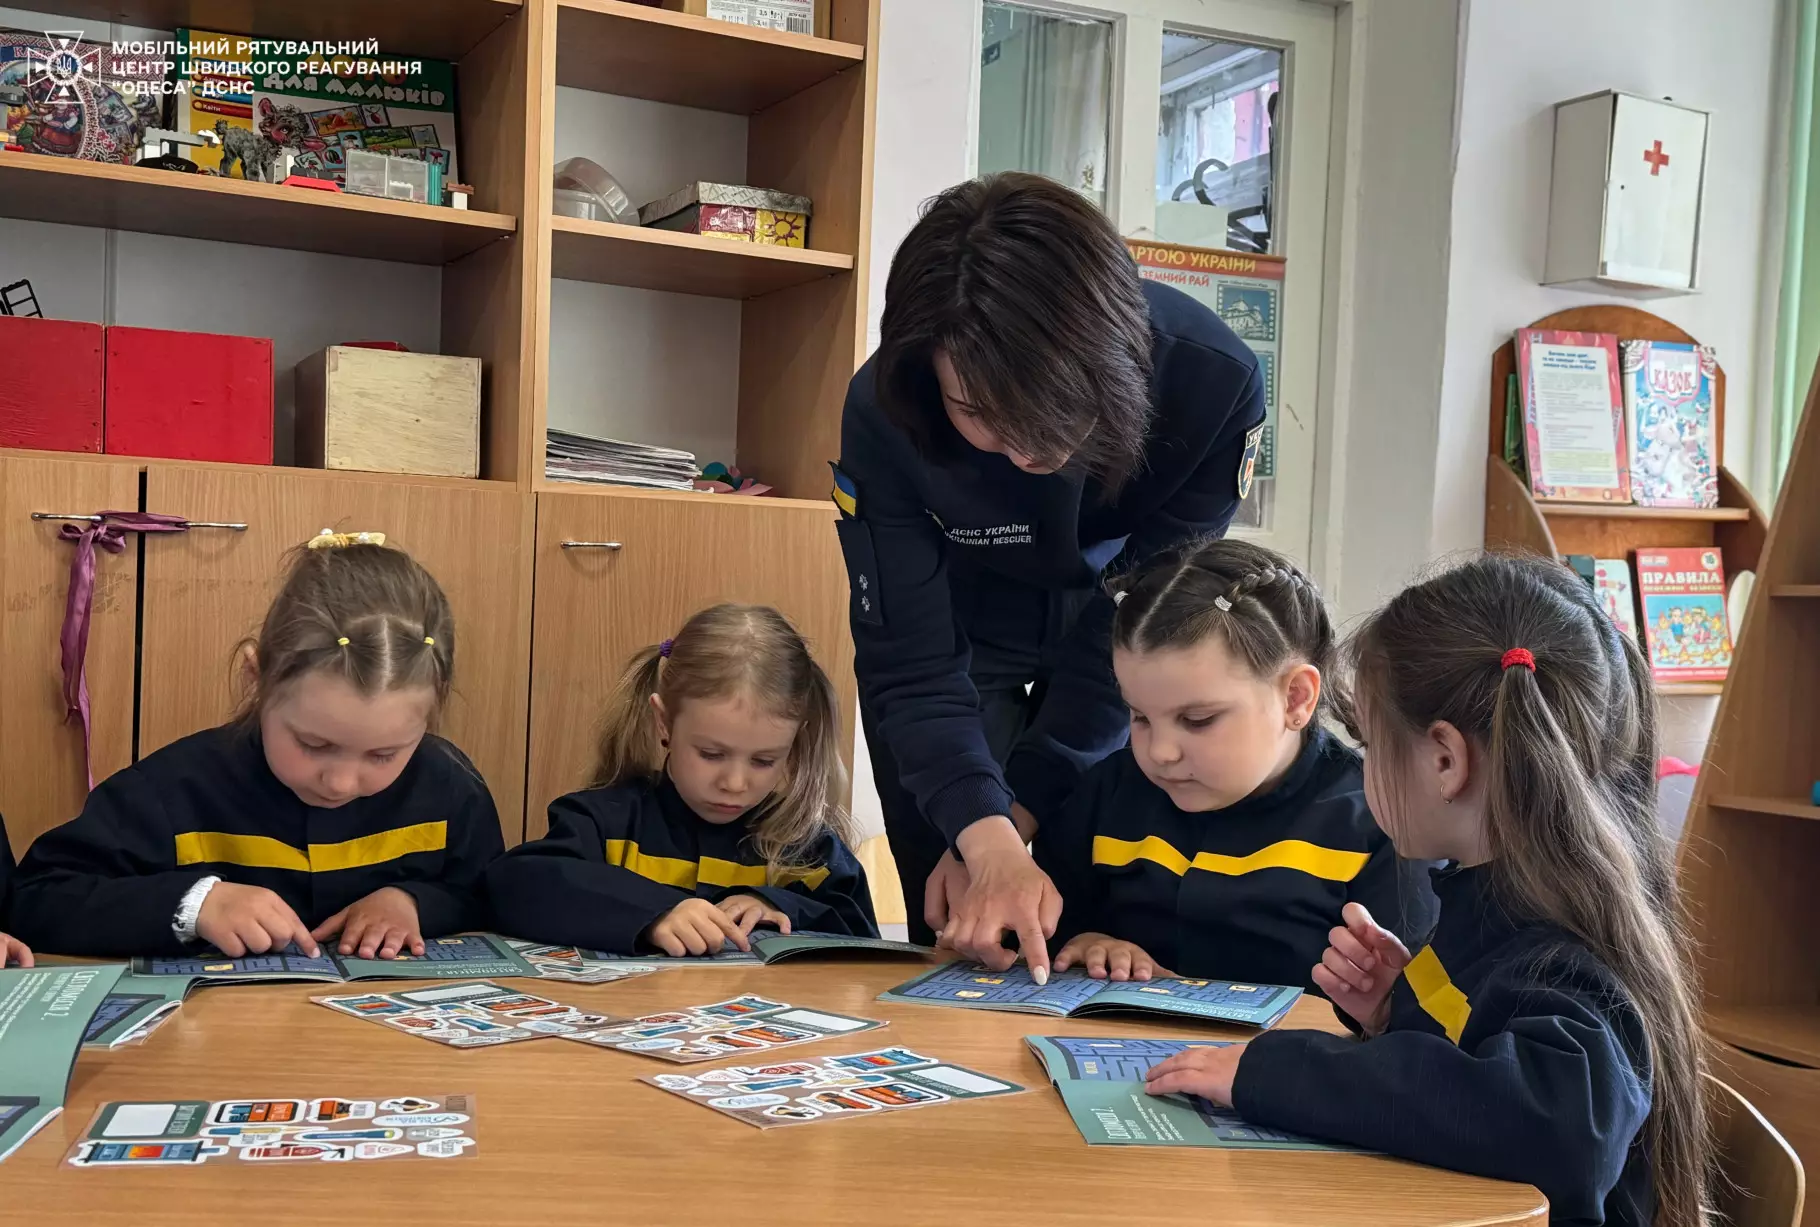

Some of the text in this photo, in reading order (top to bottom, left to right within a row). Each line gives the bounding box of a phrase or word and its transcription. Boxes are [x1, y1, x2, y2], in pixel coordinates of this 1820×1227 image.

[1128, 244, 1186, 265] АРТОЮ
[1189, 274, 1210, 288] РАЙ
[950, 523, 1030, 537] ДСНС УКРАЇНИ
[992, 535, 1032, 545] RESCUER
[1642, 571, 1722, 585] ПРАВИЛА
